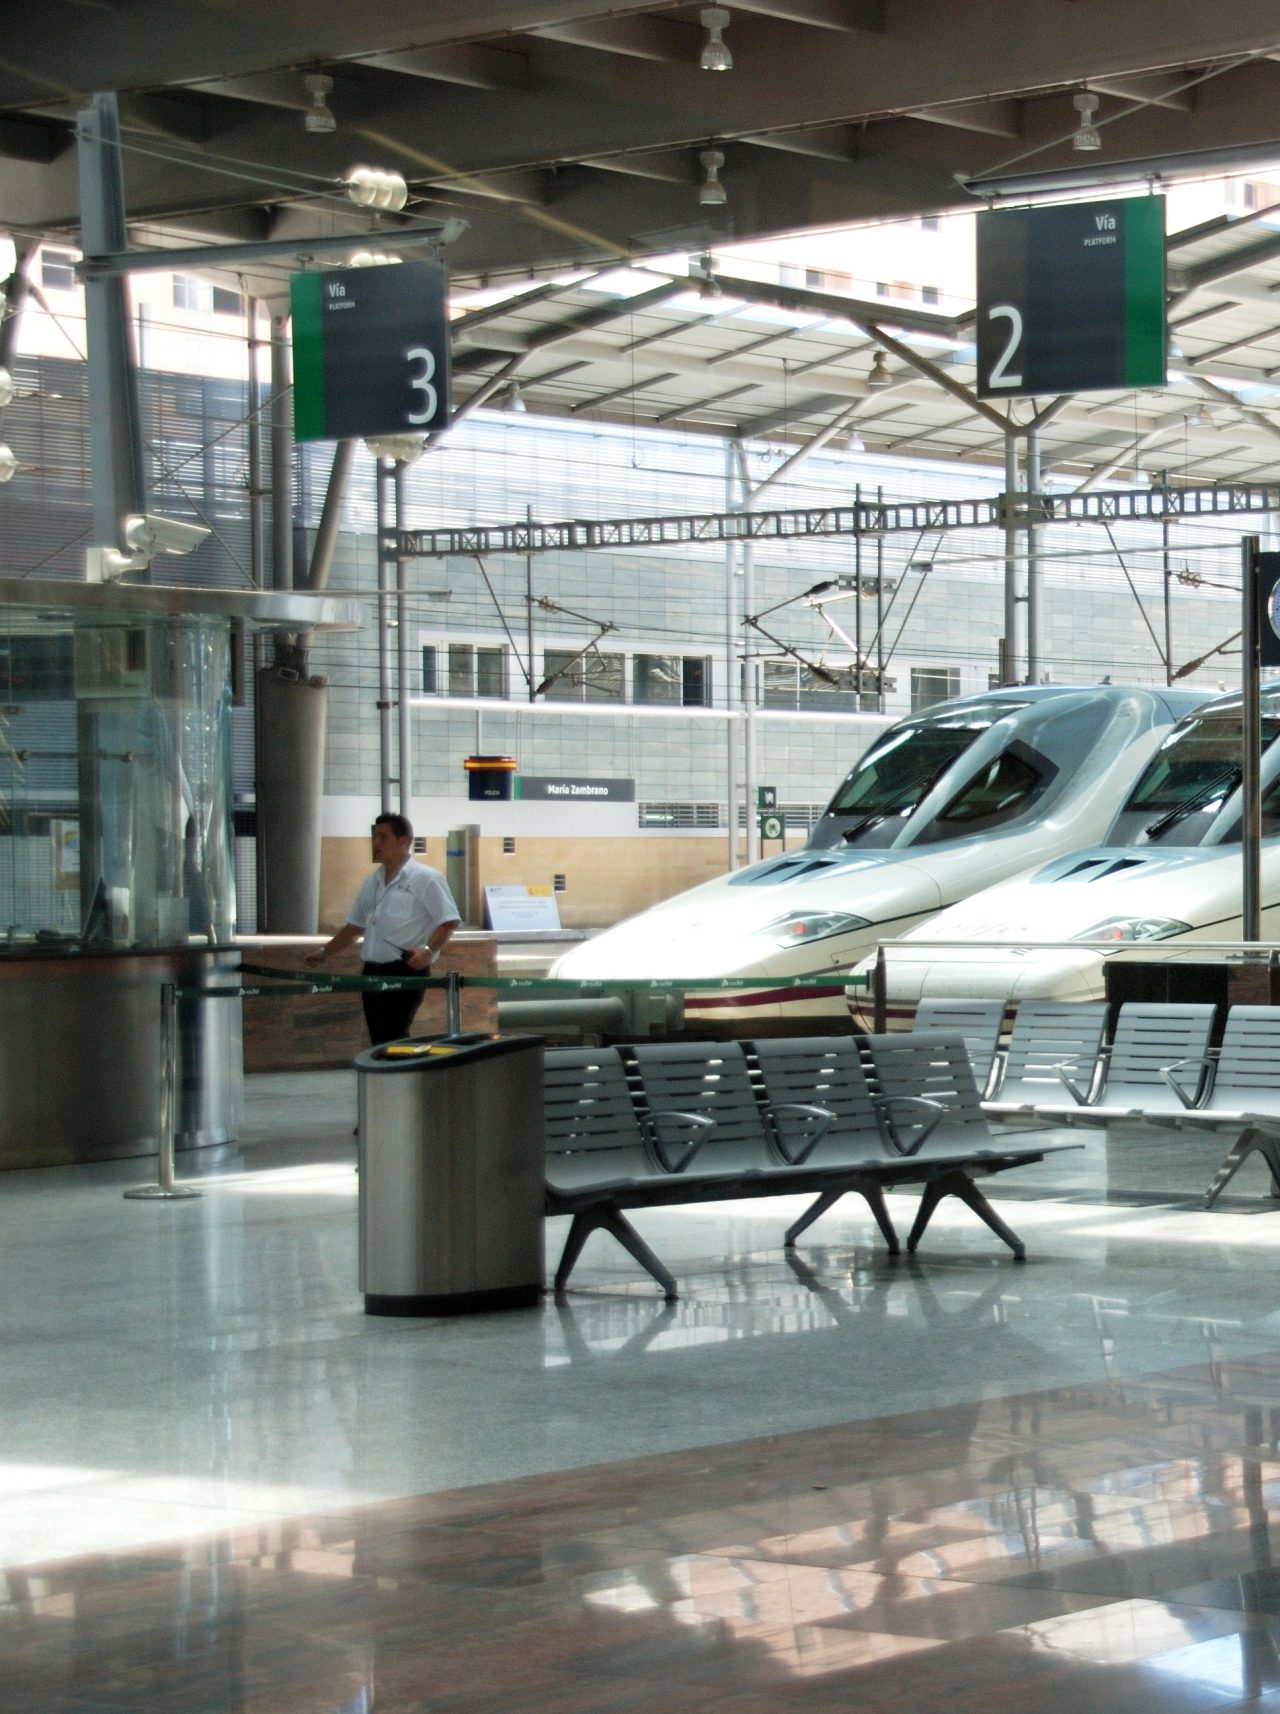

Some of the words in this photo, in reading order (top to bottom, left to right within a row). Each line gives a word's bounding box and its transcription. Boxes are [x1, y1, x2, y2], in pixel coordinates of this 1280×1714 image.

[1095, 214, 1116, 230] Vía
[1084, 236, 1116, 247] PLATFORM
[328, 283, 346, 297] Vía
[328, 301, 356, 311] PLATFORM
[989, 306, 1023, 389] 2
[407, 348, 438, 425] 3
[548, 784, 570, 795] María
[571, 785, 608, 796] Zambrano
